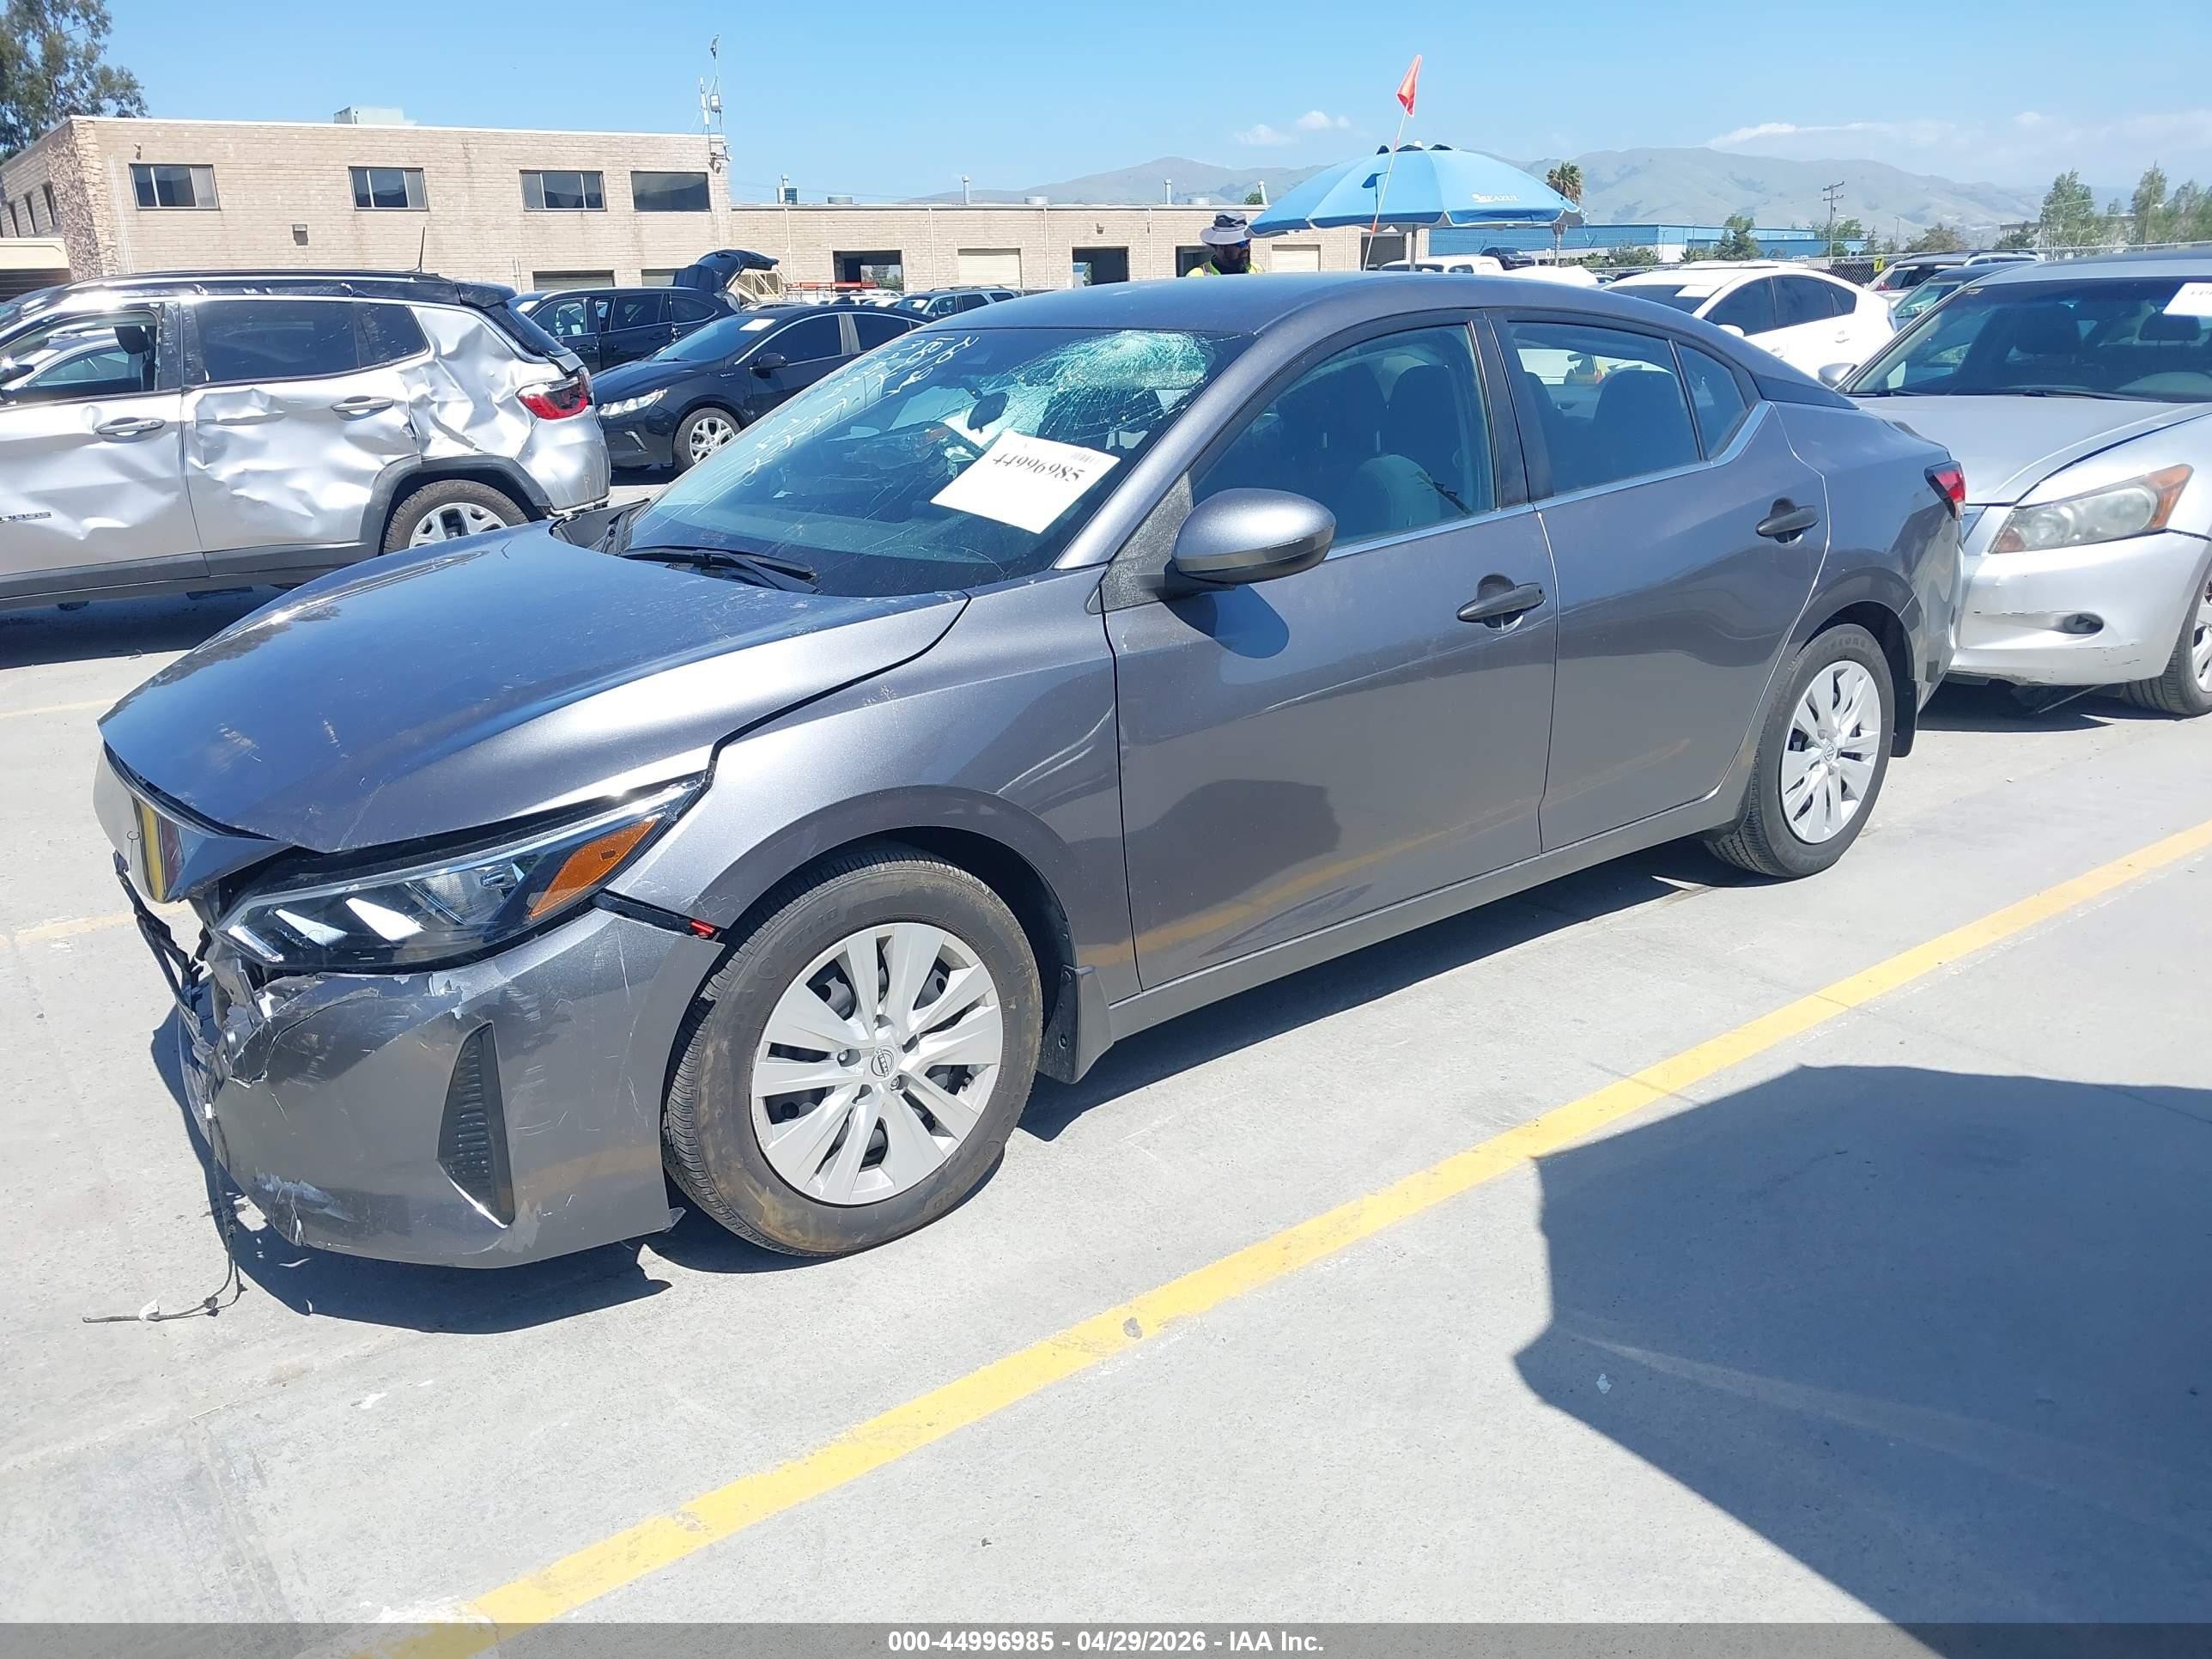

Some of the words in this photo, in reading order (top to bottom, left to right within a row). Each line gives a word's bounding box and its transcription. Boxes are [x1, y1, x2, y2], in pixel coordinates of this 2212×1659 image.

[1875, 258, 1883, 270] 7
[993, 453, 1085, 483] 44996985
[876, 1048, 890, 1079] NISSAN
